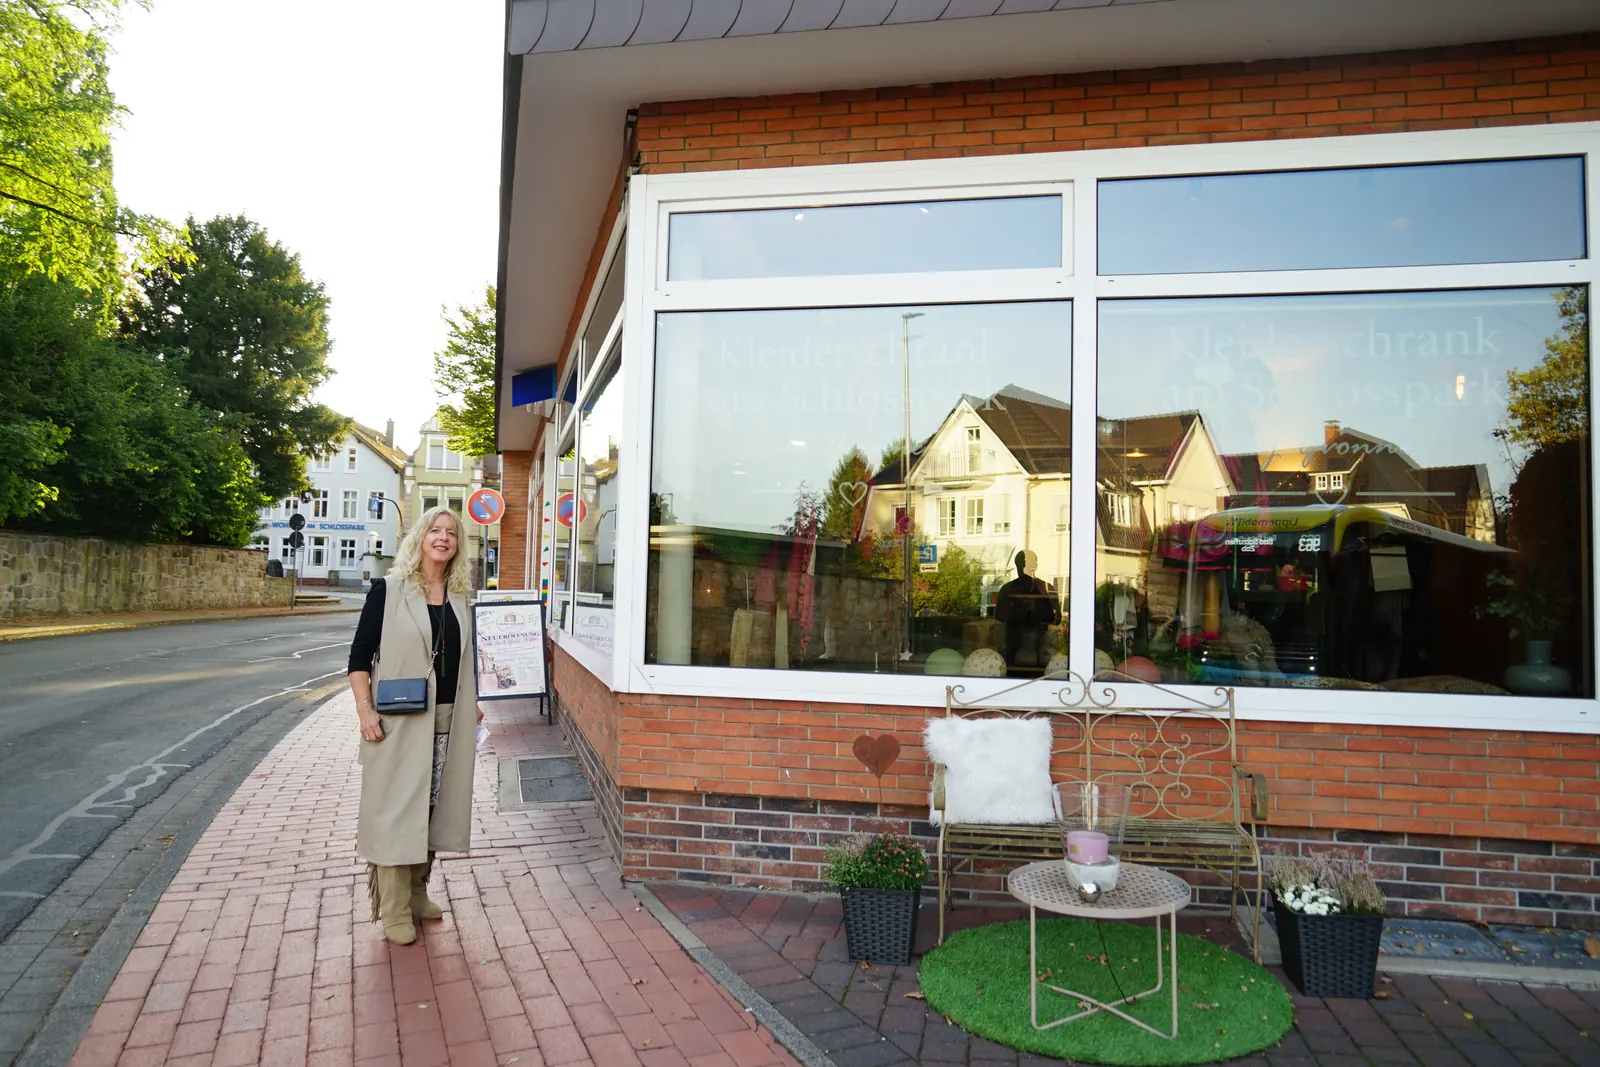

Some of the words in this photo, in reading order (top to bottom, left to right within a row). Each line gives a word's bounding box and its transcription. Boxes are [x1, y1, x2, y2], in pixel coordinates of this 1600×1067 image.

[1169, 316, 1501, 360] Kleidchrank
[781, 374, 1007, 420] Schlosspk
[1242, 366, 1510, 418] Scosspark
[1299, 440, 1409, 468] yvonn
[319, 523, 366, 531] SCHLOSSPARK
